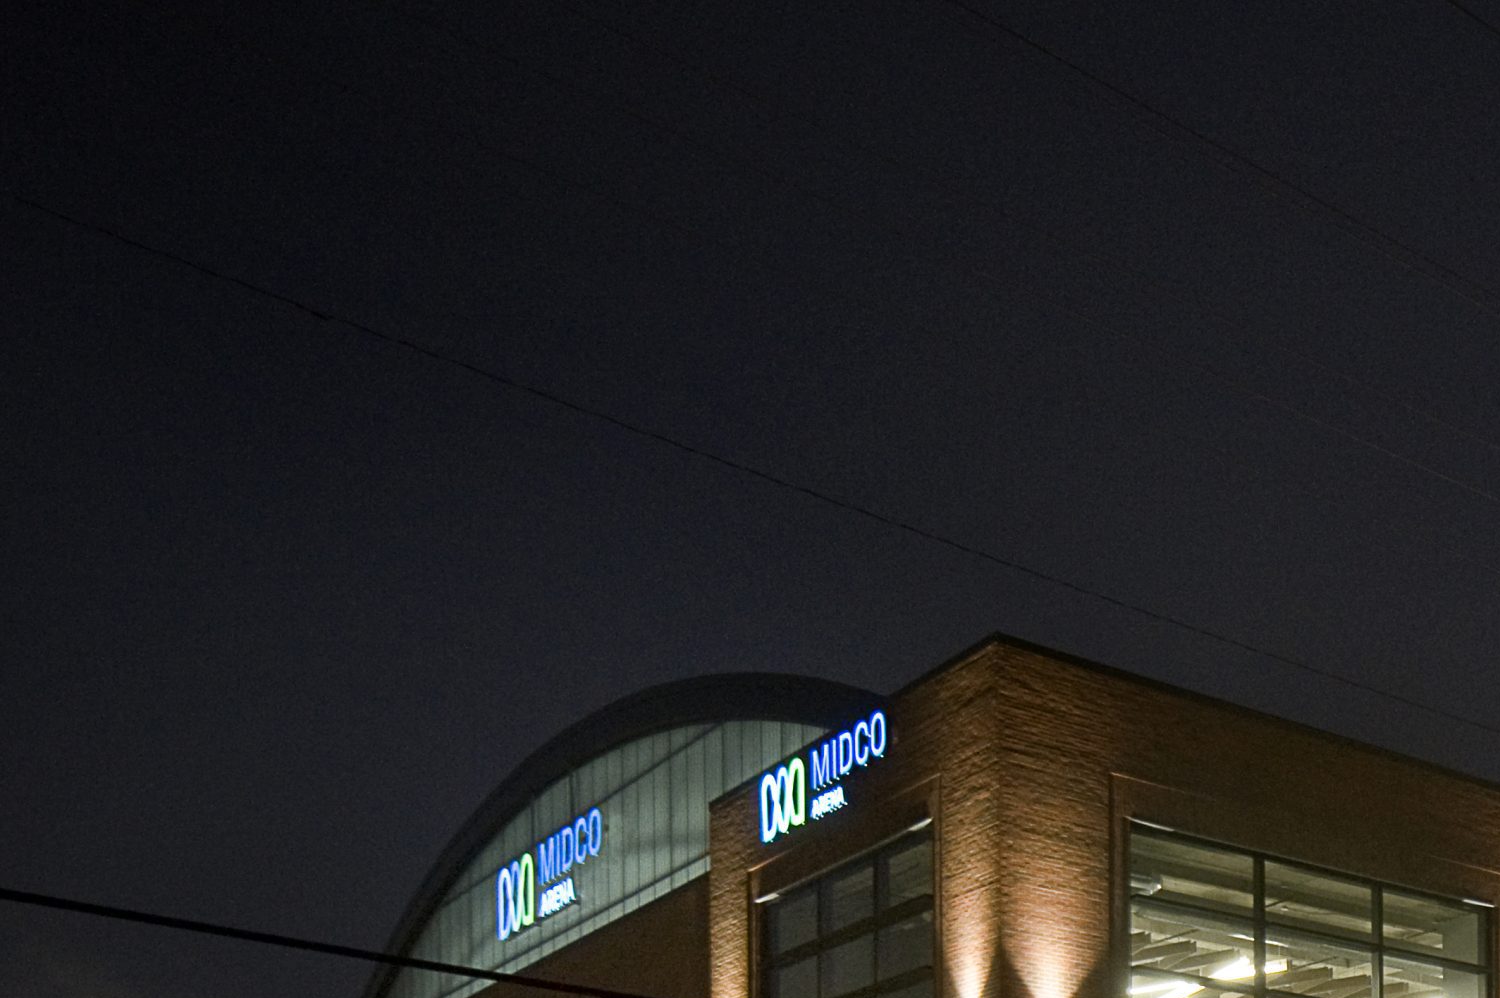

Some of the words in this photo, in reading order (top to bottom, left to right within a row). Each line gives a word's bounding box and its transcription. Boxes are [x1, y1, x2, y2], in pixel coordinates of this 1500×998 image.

[811, 711, 886, 790] MIDCO
[811, 785, 847, 820] ARENA
[538, 806, 601, 886] MIDCO
[538, 877, 577, 917] ARENA
